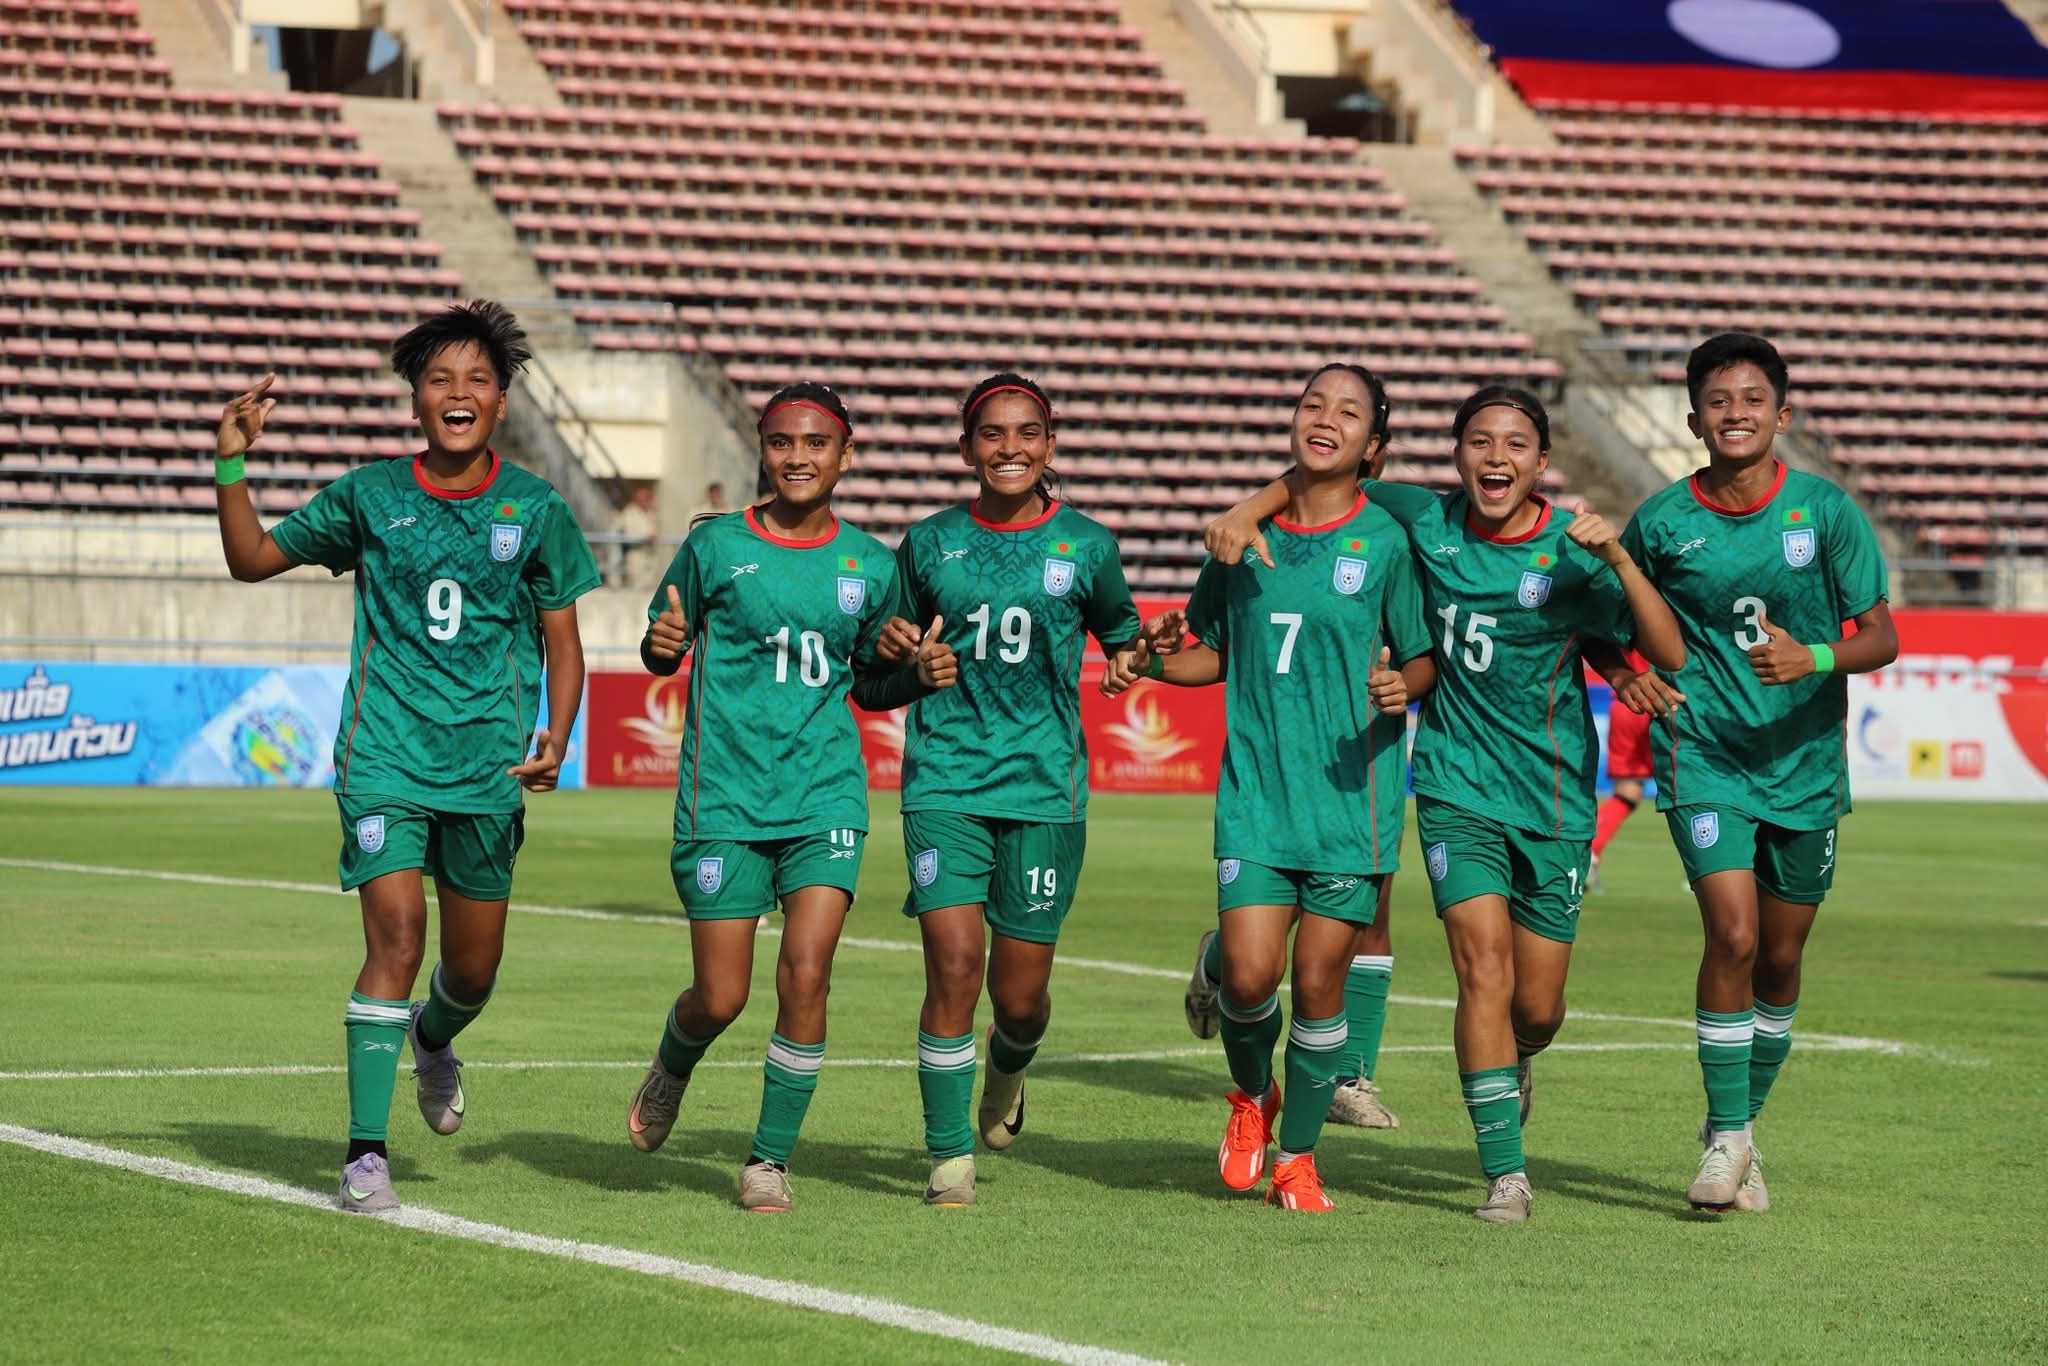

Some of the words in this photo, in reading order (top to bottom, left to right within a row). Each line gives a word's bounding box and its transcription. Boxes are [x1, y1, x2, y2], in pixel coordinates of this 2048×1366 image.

[428, 578, 462, 641] 9
[966, 603, 1032, 664] 19
[1437, 603, 1498, 673] 15
[1733, 596, 1770, 652] 3
[765, 626, 830, 688] 10
[1270, 612, 1303, 674] 7
[1824, 829, 1835, 857] 3
[1026, 866, 1056, 897] 19
